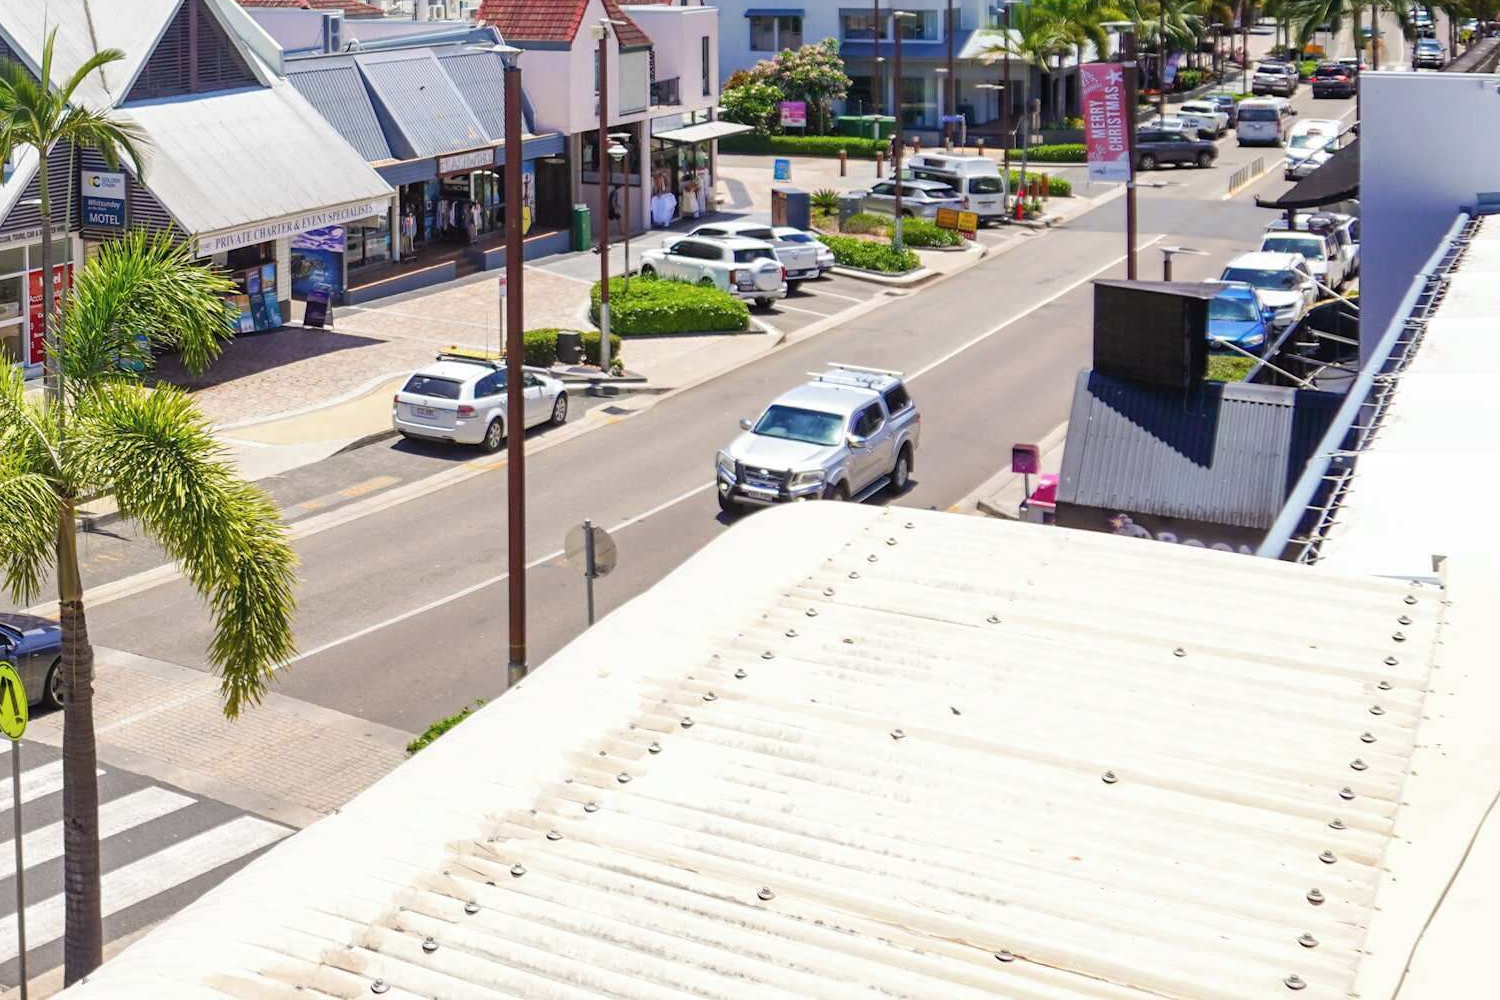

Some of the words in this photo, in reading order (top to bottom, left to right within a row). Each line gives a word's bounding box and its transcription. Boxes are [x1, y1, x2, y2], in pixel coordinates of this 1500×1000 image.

[1089, 100, 1106, 138] MERRY
[1105, 86, 1124, 152] CHRISTMAS
[89, 213, 120, 225] MOTEL
[216, 231, 252, 249] PRIVATE
[254, 220, 293, 241] CHARTER
[293, 222, 300, 231] &
[302, 212, 328, 229] EVENT
[328, 203, 373, 221] SPECIALISTS
